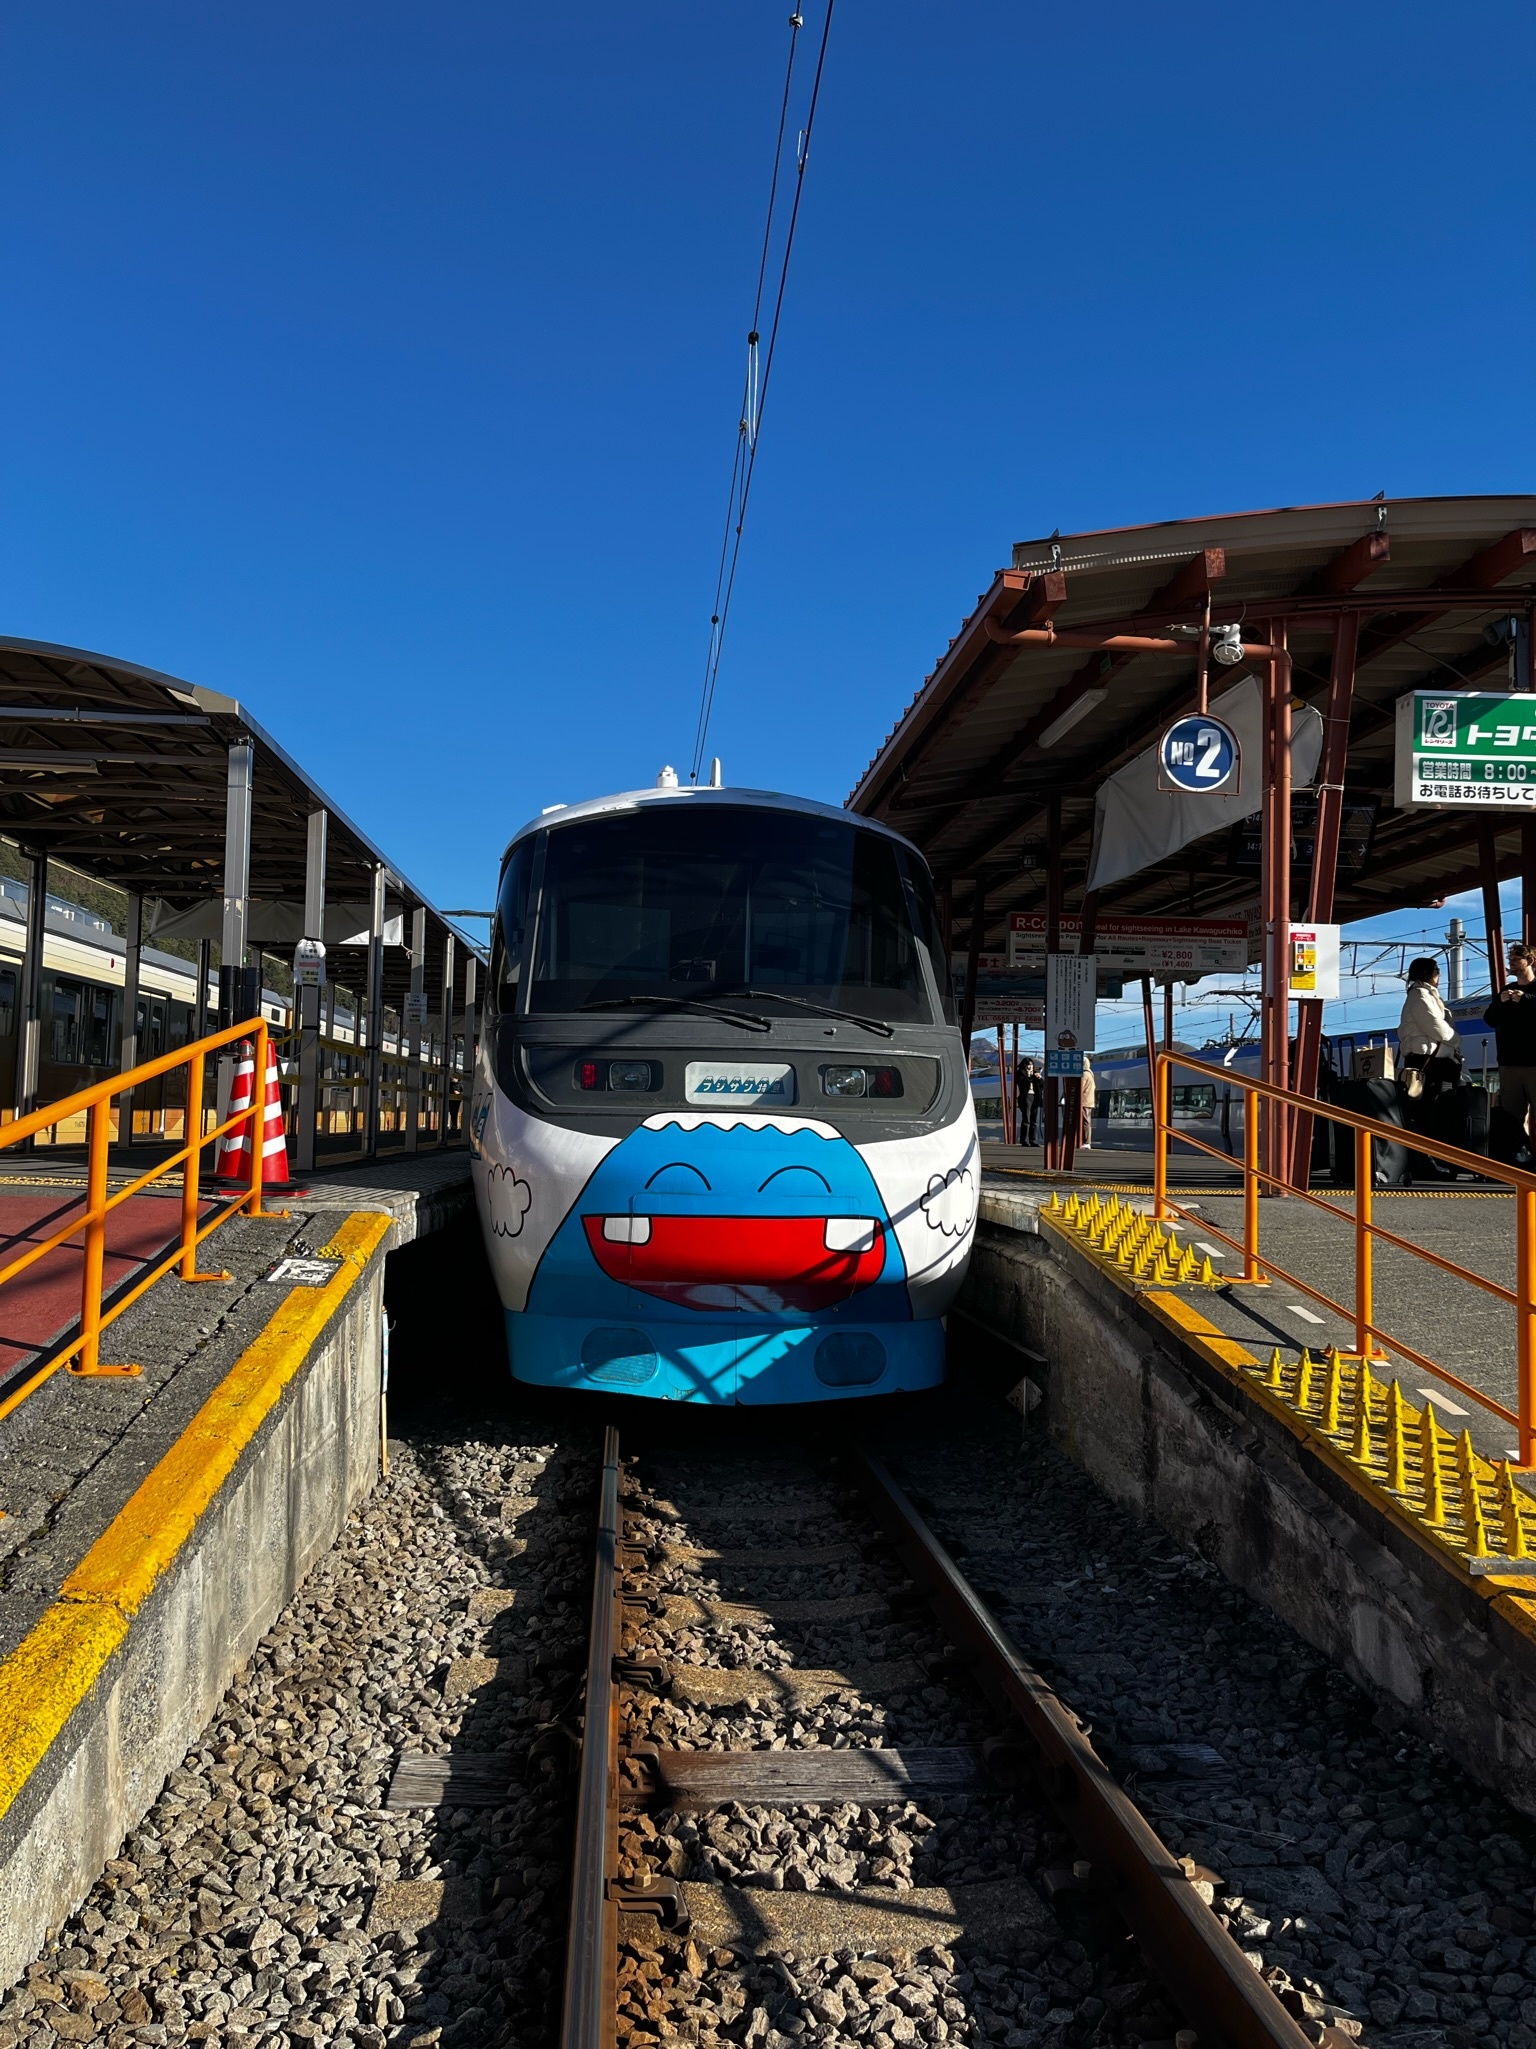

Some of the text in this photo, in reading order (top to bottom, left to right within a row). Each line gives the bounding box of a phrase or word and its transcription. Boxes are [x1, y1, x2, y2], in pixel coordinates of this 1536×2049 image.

[1196, 728, 1221, 778] 2
[1422, 760, 1472, 780] 営業時間
[1016, 916, 1083, 933] R-Copon
[1109, 923, 1119, 932] for
[1121, 924, 1164, 934] sightseeing
[1165, 924, 1173, 933] in
[1174, 926, 1193, 934] Lake
[1193, 926, 1243, 936] Kawaguchiko
[1162, 951, 1193, 960] ¥2,800
[1162, 960, 1193, 968] (¥1,400)
